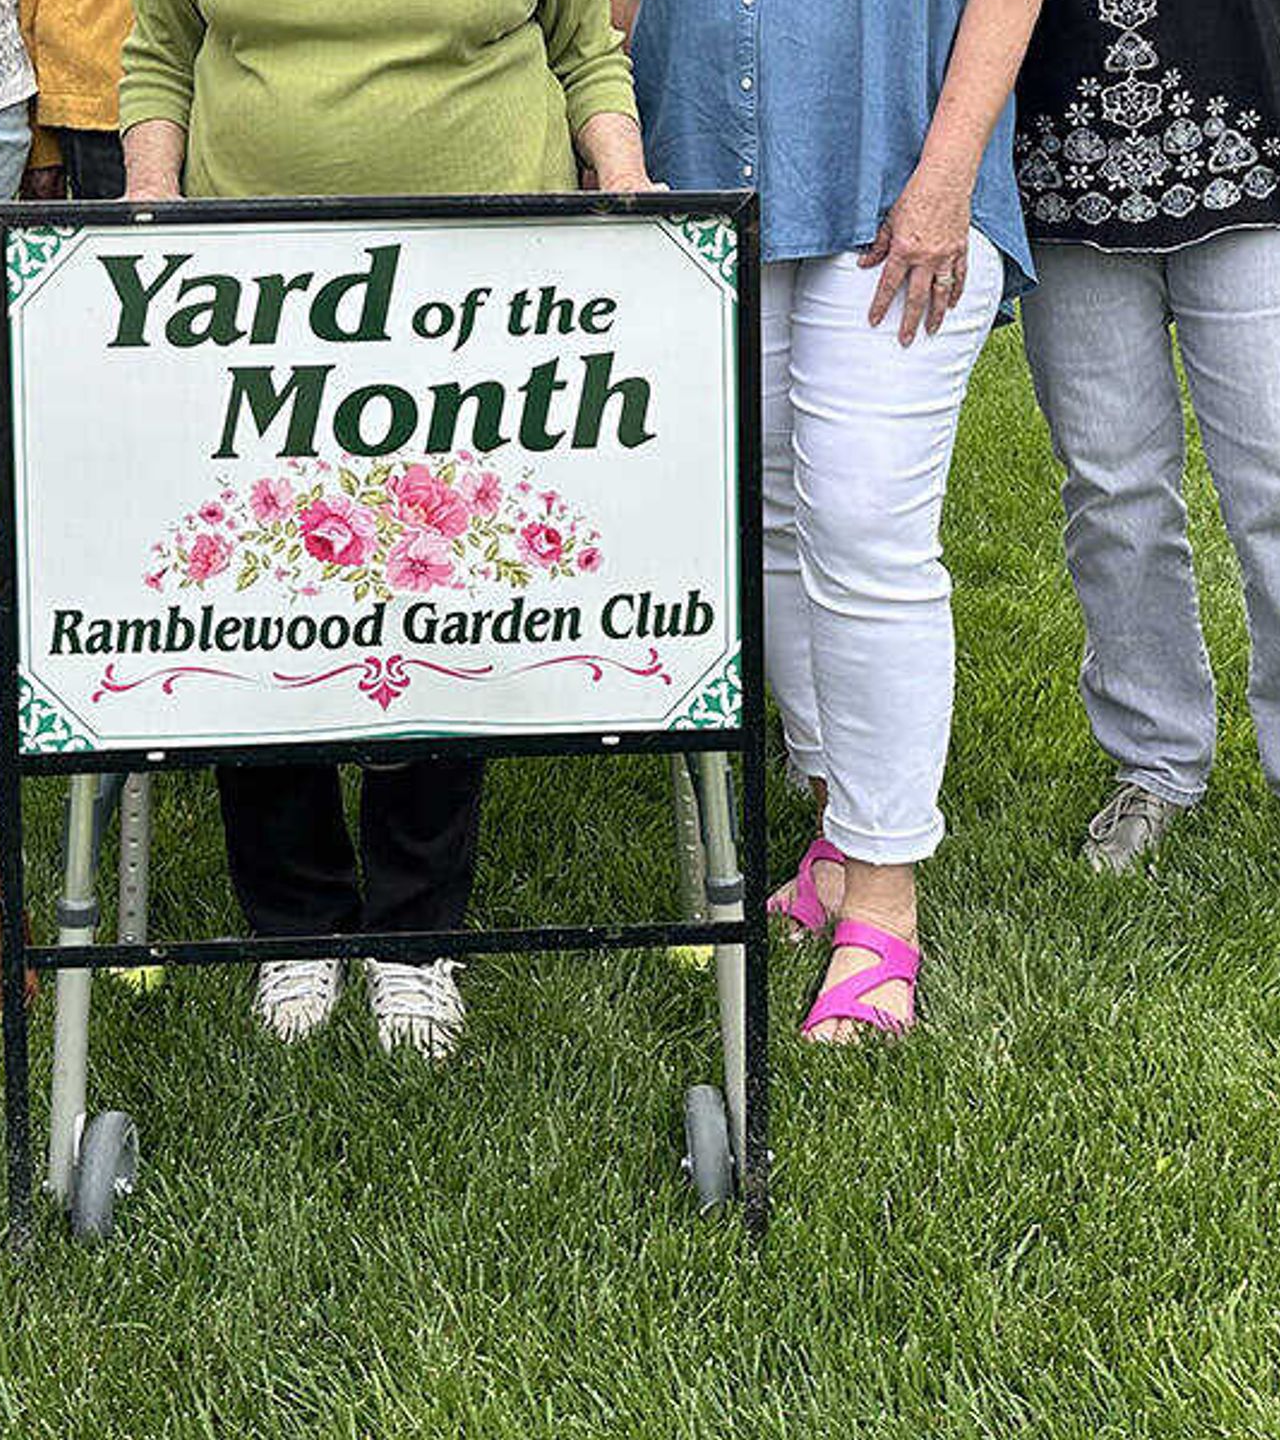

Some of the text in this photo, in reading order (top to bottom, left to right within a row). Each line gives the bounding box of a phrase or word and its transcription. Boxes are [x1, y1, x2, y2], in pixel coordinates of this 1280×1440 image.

[97, 244, 616, 351] Yard of the
[211, 352, 656, 459] Month
[50, 590, 713, 655] Ramblewood Garden Club
